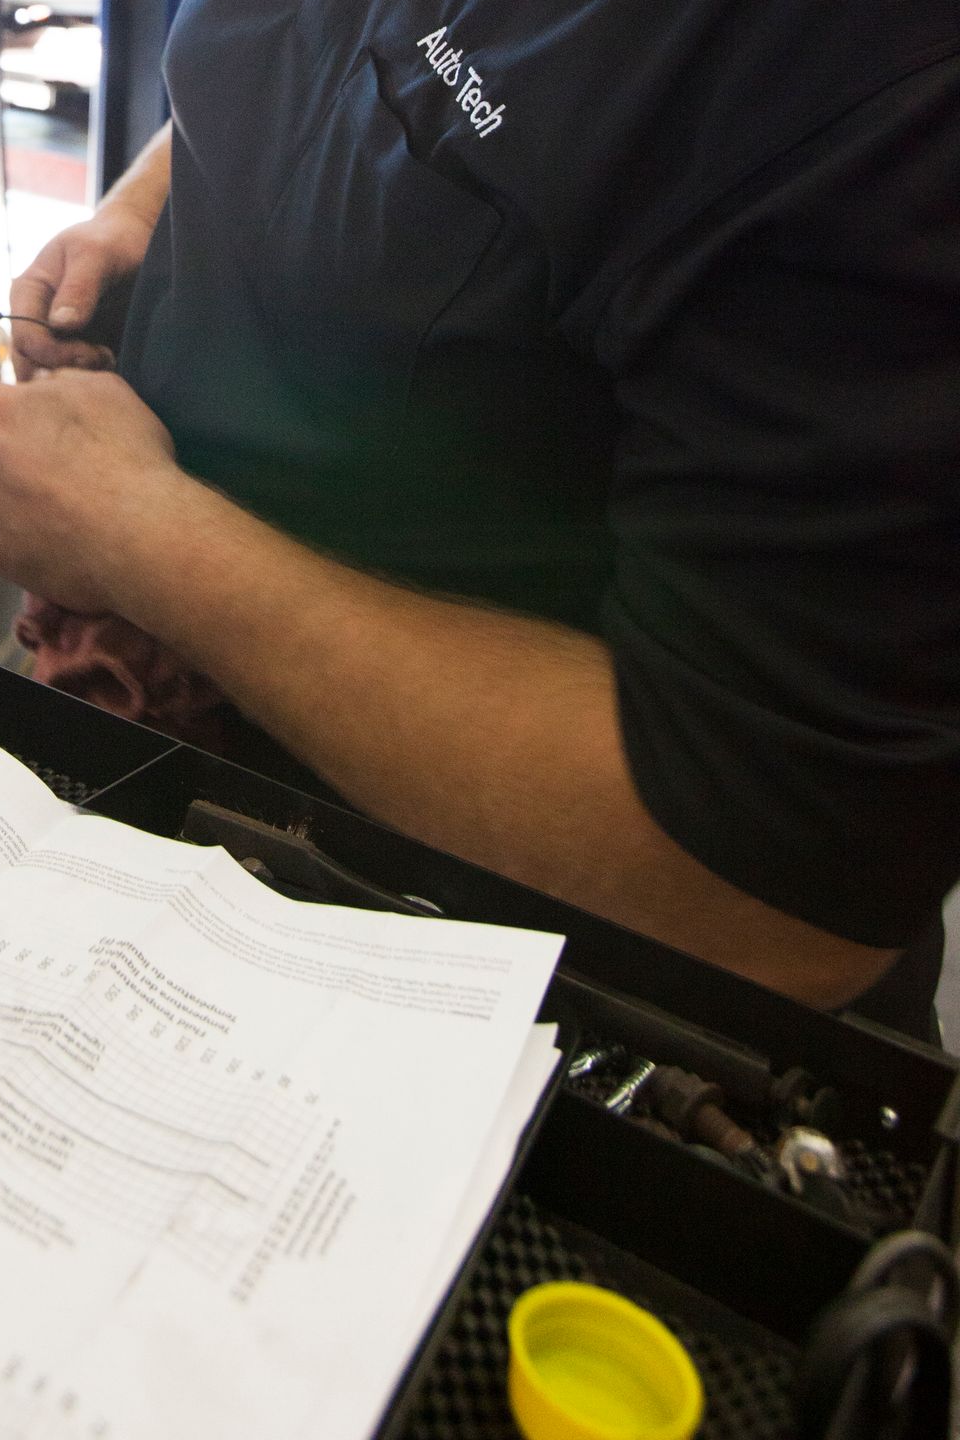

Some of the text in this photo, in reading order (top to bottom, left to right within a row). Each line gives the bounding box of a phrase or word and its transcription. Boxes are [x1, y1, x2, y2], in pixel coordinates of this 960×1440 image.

[151, 967, 165, 980] du
[110, 963, 174, 1021] Temperature
[140, 976, 158, 991] del
[159, 991, 229, 1034] Temperatura
[177, 1019, 206, 1037] Fluid
